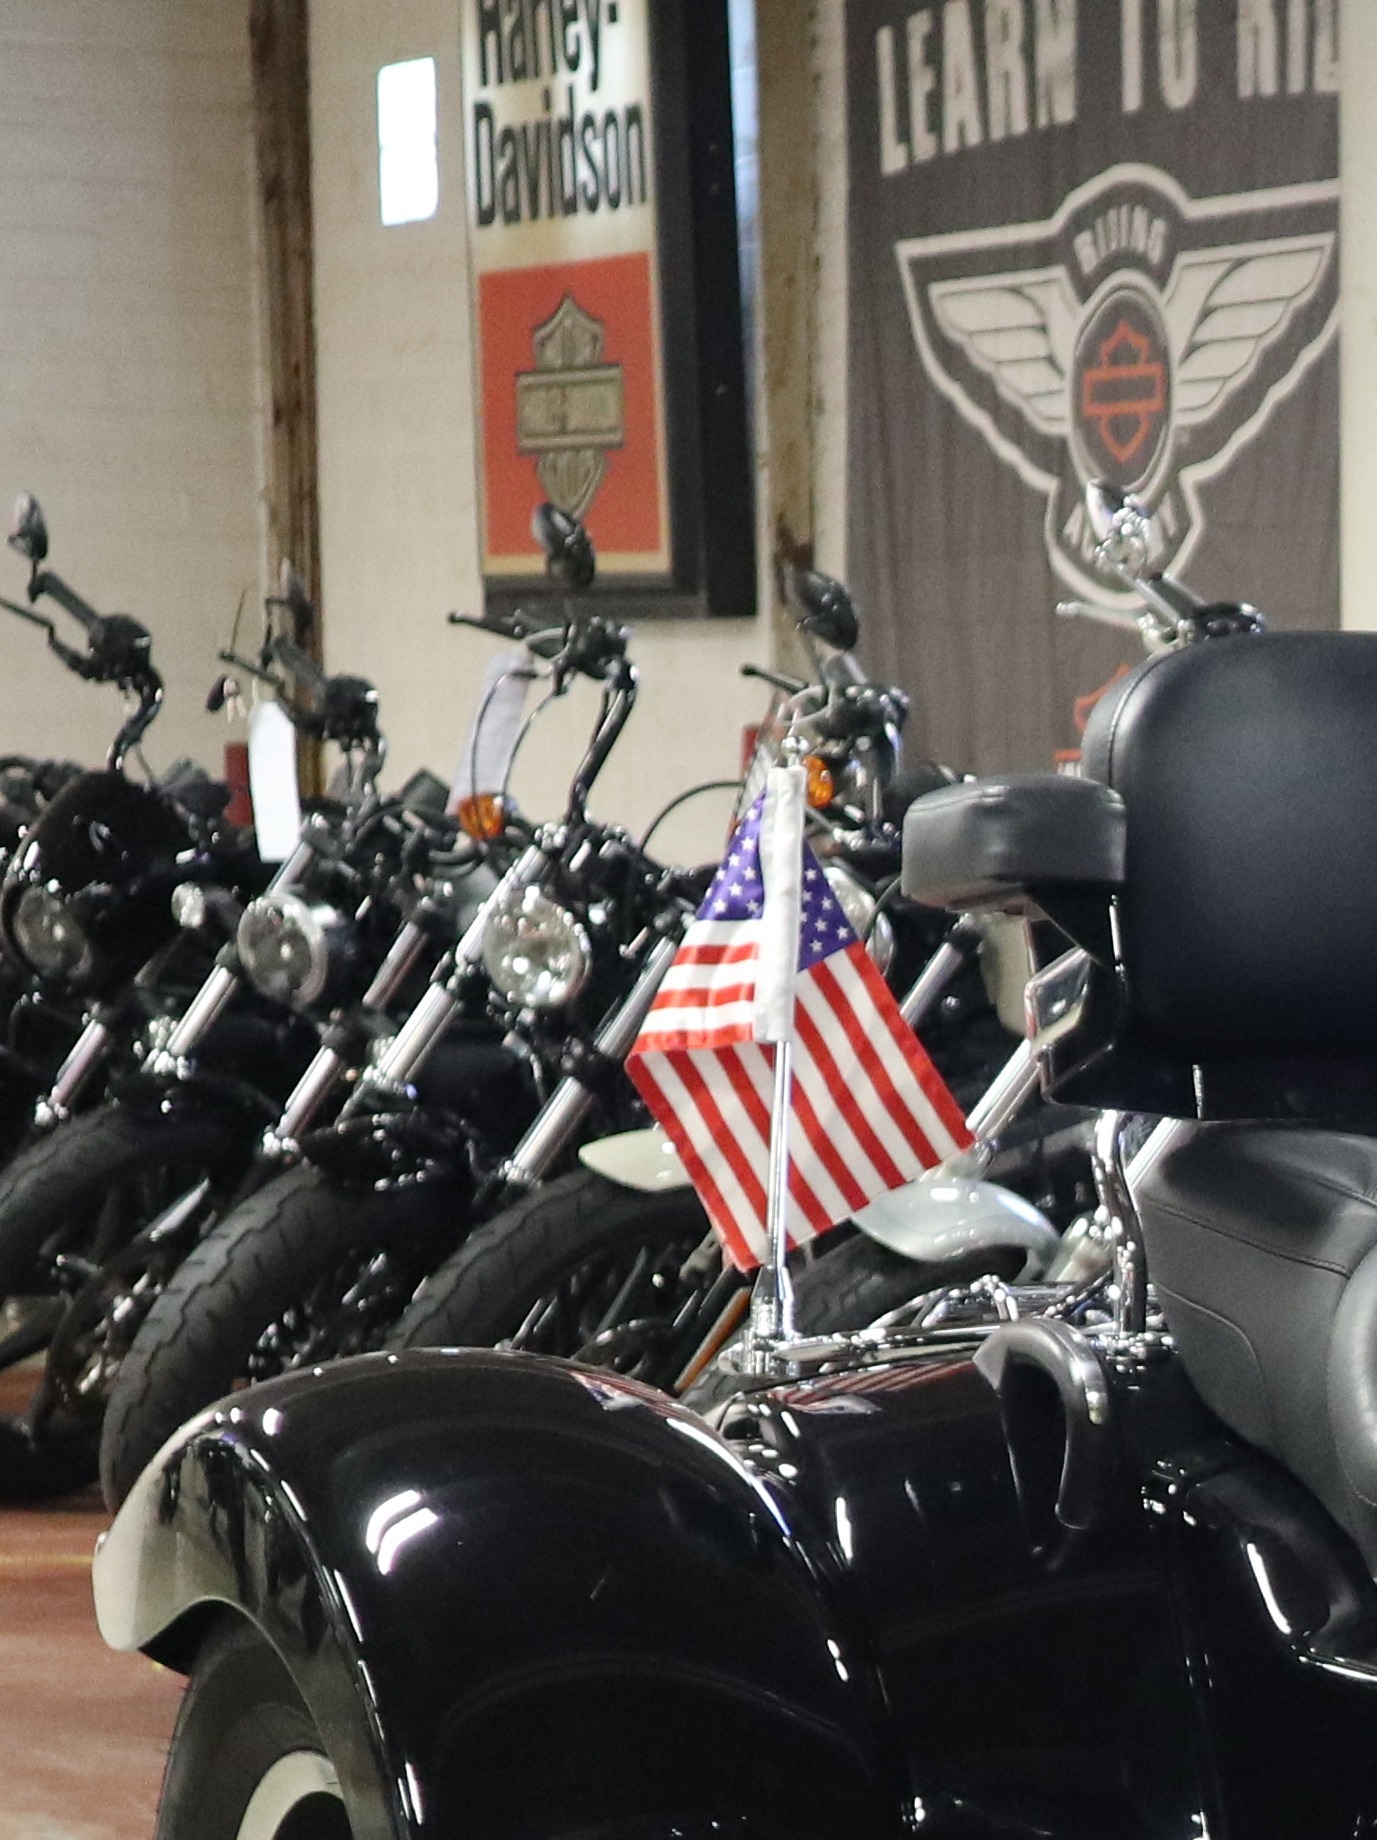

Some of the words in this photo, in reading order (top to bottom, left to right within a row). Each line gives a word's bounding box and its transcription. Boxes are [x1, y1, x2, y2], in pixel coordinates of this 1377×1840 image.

[478, 0, 618, 91] Harley-
[875, 0, 1077, 177] LEARN
[1120, 0, 1199, 113] TO
[474, 82, 647, 228] Davidson
